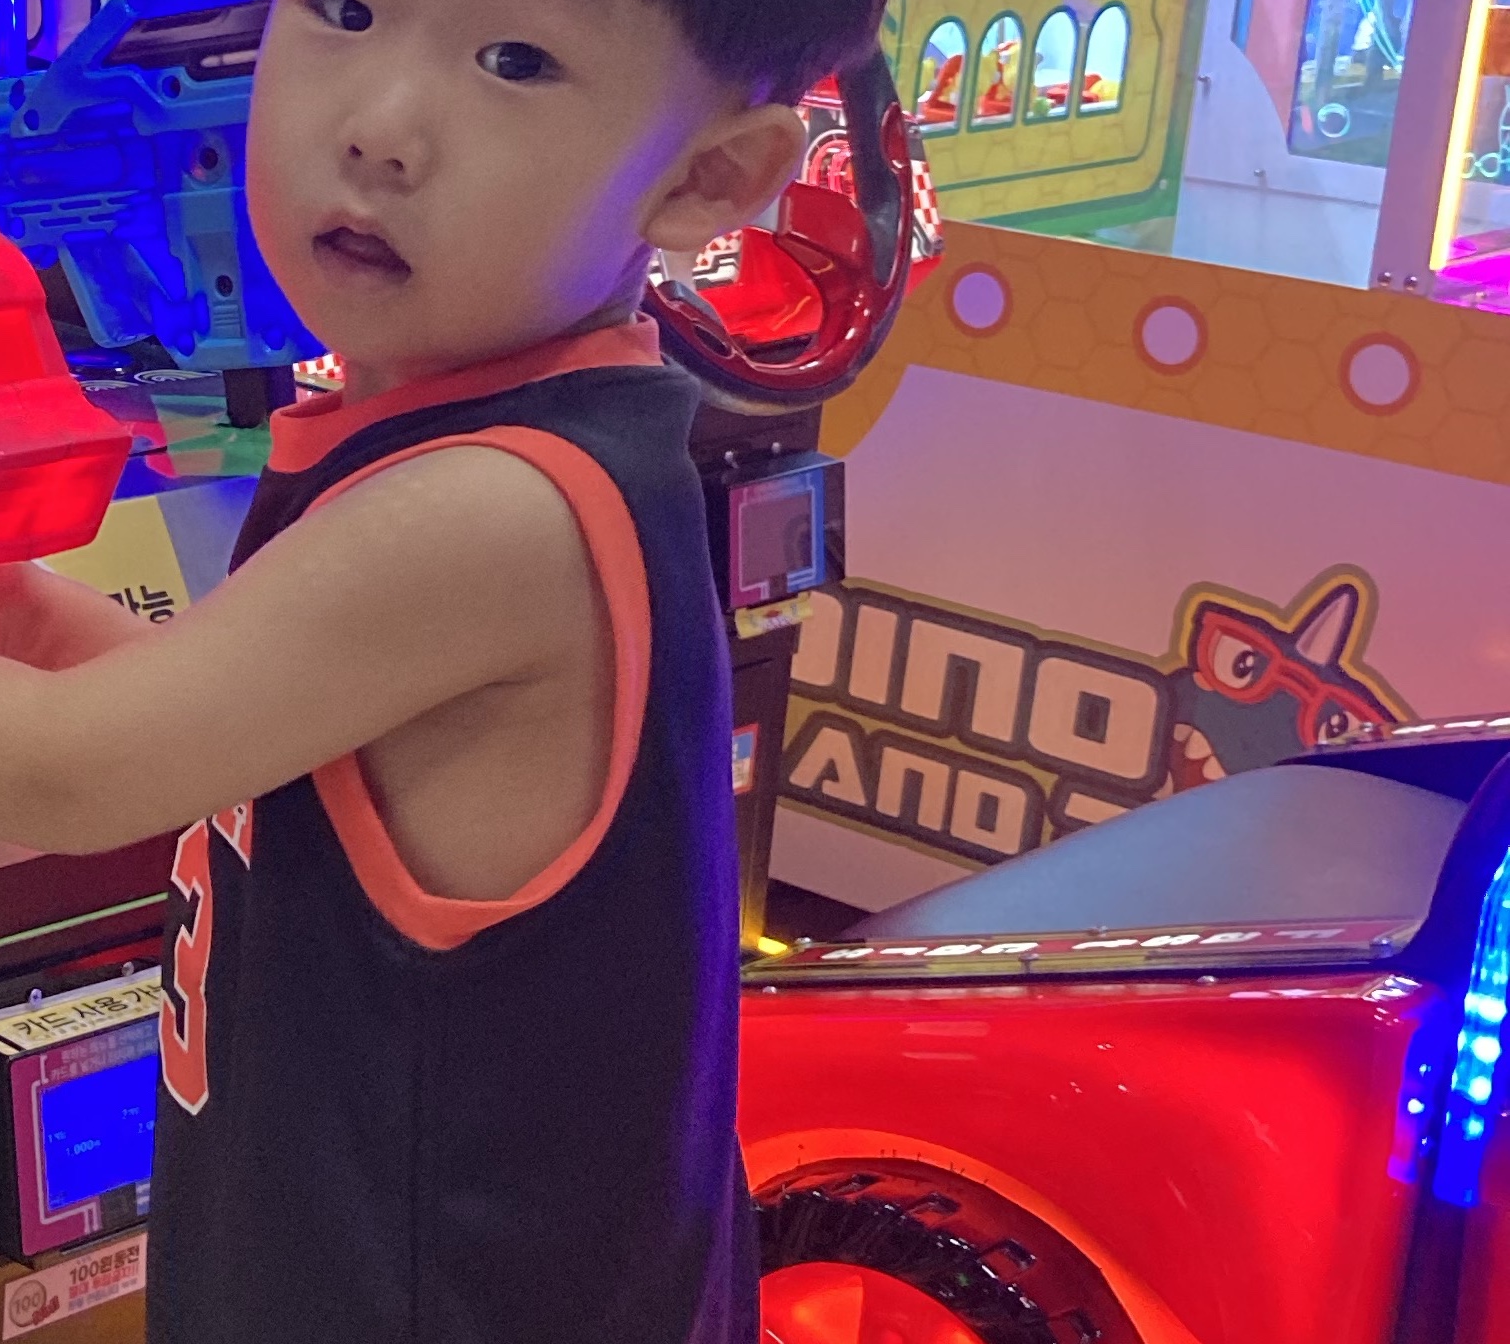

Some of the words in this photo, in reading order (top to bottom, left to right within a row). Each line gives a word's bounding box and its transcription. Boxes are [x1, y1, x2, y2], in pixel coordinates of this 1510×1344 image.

[788, 725, 1027, 855] AND
[11, 1011, 77, 1036] 카드
[72, 996, 129, 1020] 사용
